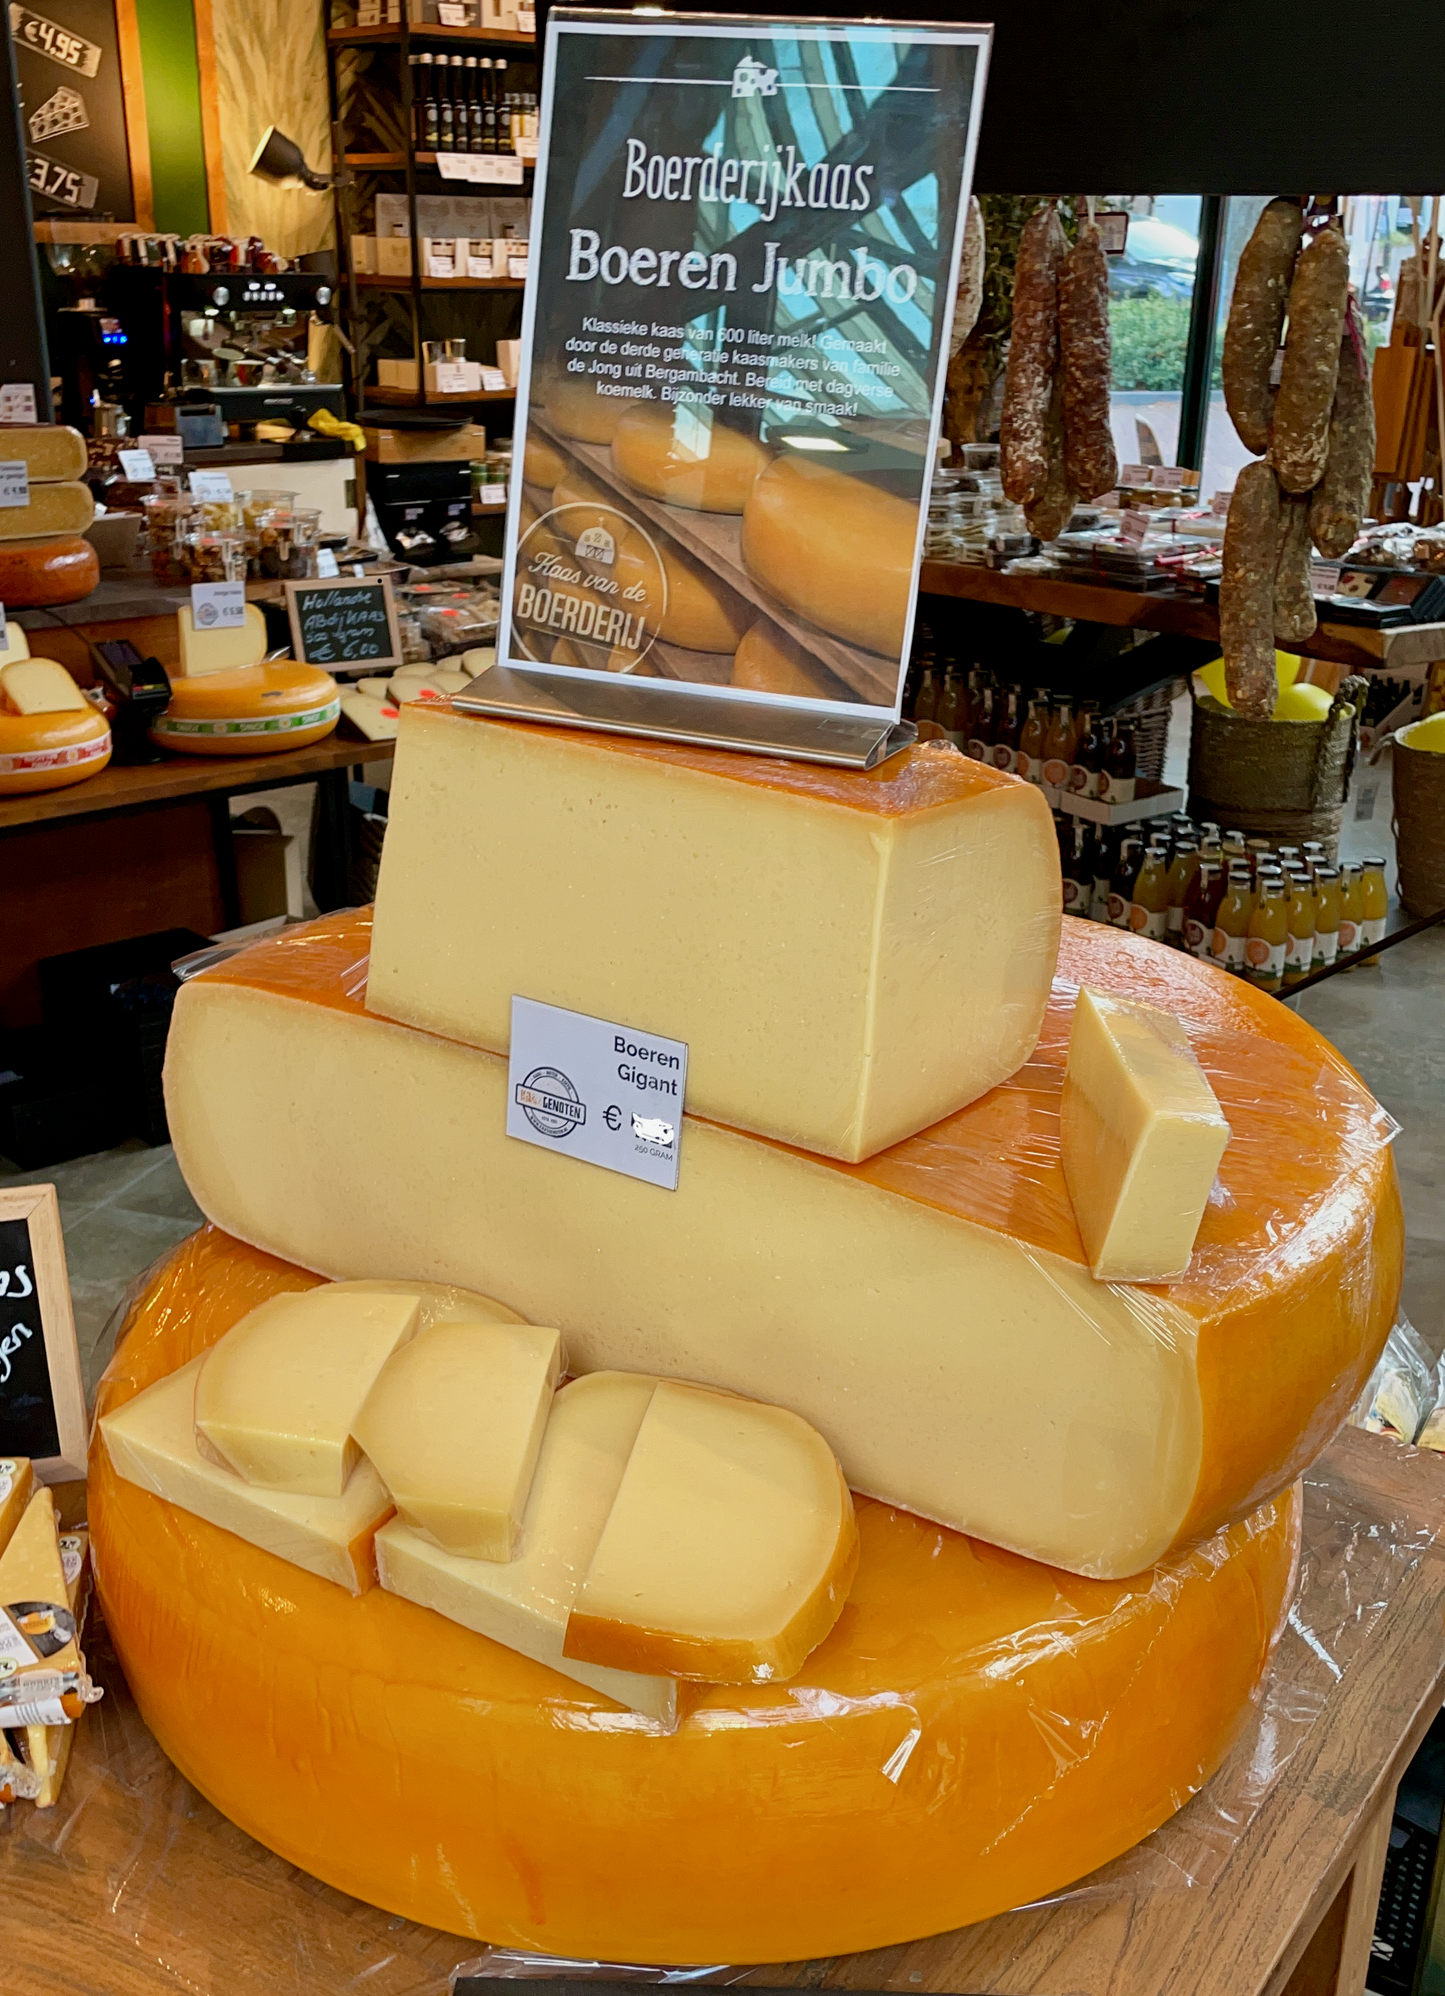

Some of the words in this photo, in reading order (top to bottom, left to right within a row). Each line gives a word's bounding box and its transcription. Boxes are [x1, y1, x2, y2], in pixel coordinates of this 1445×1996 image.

[622, 138, 874, 222] Boerderijkaas
[565, 228, 738, 292] Boeren
[751, 241, 918, 304] Jumbo
[582, 317, 648, 336] Klassieke
[651, 322, 685, 339] kaas
[687, 328, 714, 341] van
[716, 328, 744, 343] 600
[747, 329, 775, 345] liter
[777, 333, 816, 349] melk!
[820, 335, 887, 354] Gemaakt
[565, 337, 598, 353] door
[600, 340, 618, 355] de
[620, 341, 661, 358] derde
[663, 346, 729, 364] generatie
[731, 350, 819, 370] kaasmakers
[822, 359, 849, 373] van
[853, 359, 901, 377] familie
[567, 358, 586, 373] de
[588, 359, 622, 379] Jong
[625, 363, 643, 378] uit
[645, 364, 741, 386] Bergambacht.
[745, 372, 792, 390] Bereid
[795, 378, 823, 391] met
[826, 379, 894, 398] dagverse
[596, 381, 657, 400] koemelk.
[660, 386, 727, 405] Bijzonder
[728, 392, 773, 409] lekker
[776, 400, 802, 412] van
[805, 402, 858, 417] smaak!
[528, 552, 582, 584] Kaas
[582, 573, 620, 594] van
[622, 580, 647, 602] de
[516, 583, 645, 650] BOERDERIJ
[614, 1035, 680, 1070] Boeren
[617, 1063, 678, 1096] Gigant
[602, 1105, 622, 1131] €
[634, 1144, 648, 1154] 250
[649, 1148, 673, 1162] GRAM
